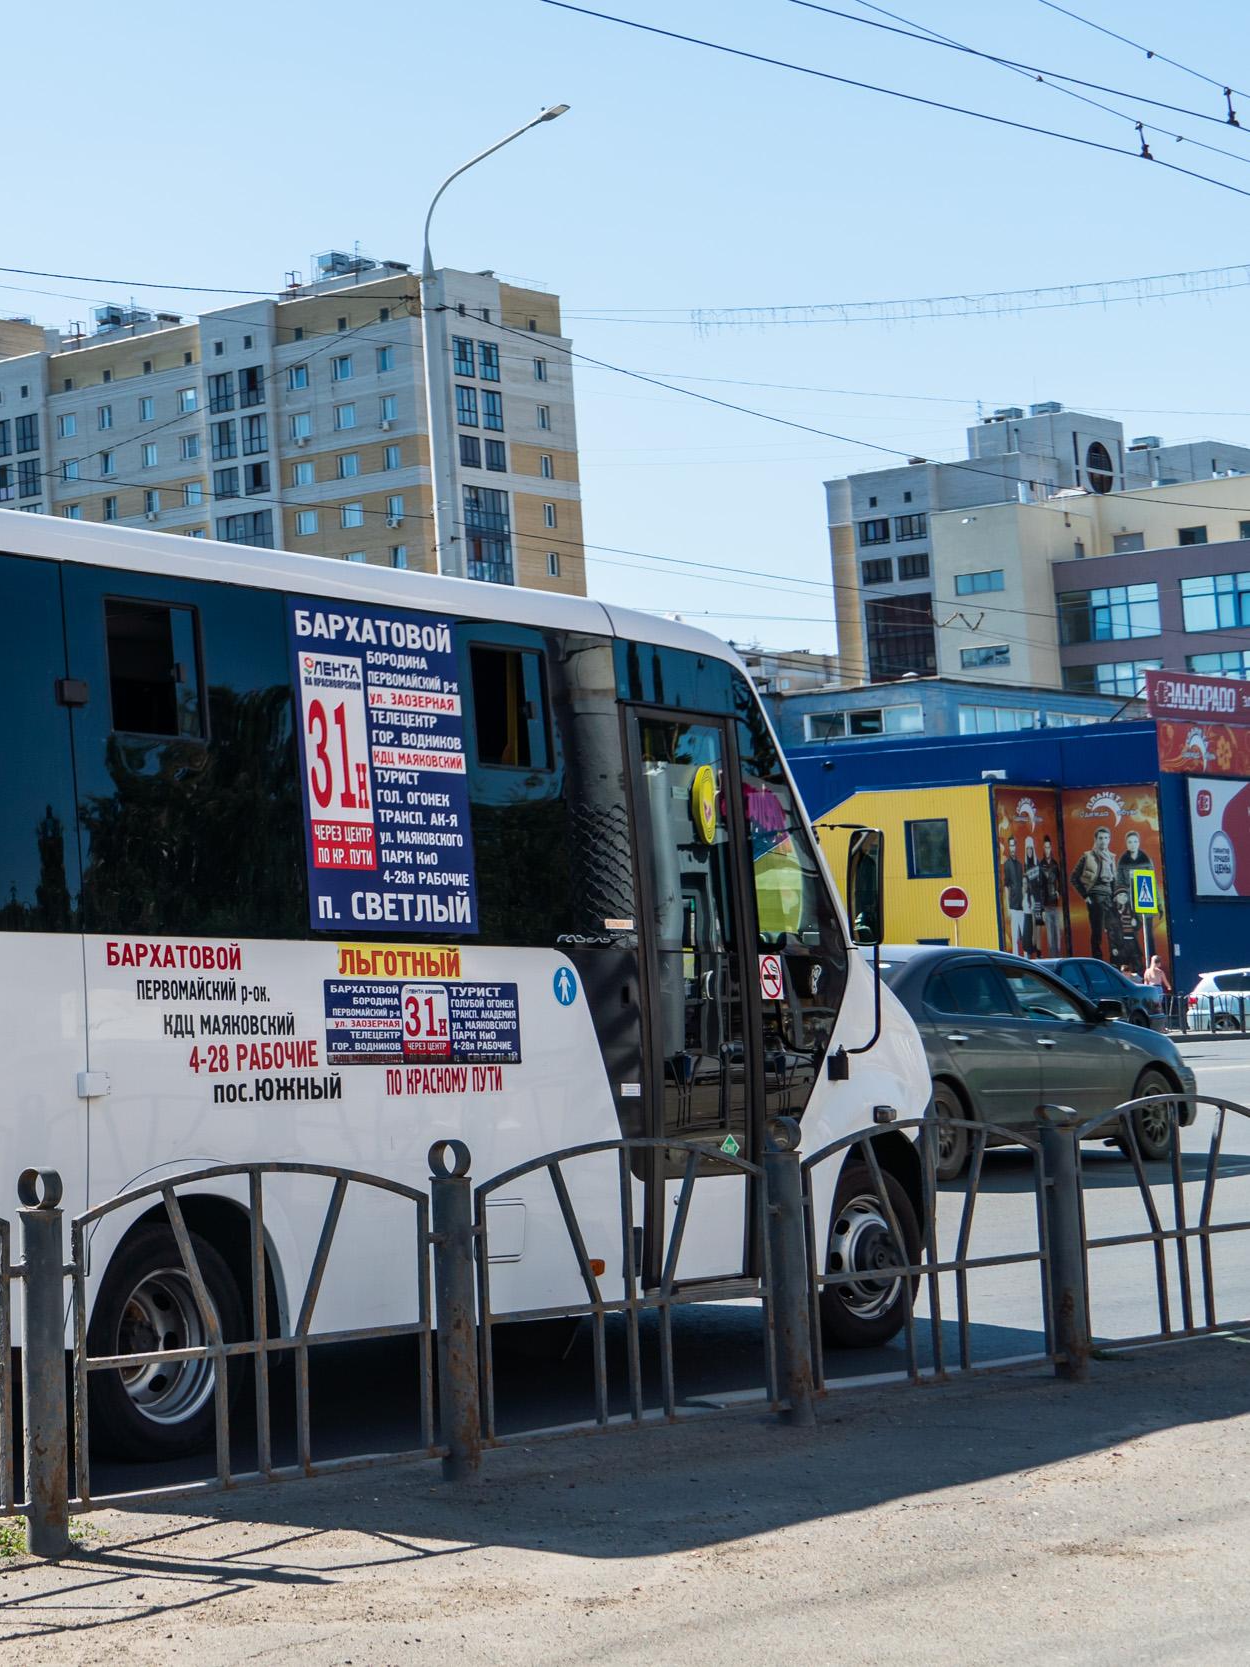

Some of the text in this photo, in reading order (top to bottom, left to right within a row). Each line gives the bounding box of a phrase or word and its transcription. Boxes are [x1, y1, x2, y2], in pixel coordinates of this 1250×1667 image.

[294, 608, 452, 654] БАРХАТОВОЙ
[313, 660, 361, 679] ЛЕНТА
[366, 650, 429, 671] БОРОДИНА
[367, 670, 442, 692] ПЕРВОМАЙСКИЙ
[370, 692, 455, 712] ул. ЗАОЗЕРНАЯ
[1166, 681, 1236, 713] ЭЛЬДОРАДО
[370, 710, 438, 729] ТЕЛЕЦЕНТР
[372, 729, 462, 751] ГОР. ВОДНИКОВ
[373, 750, 463, 770] КДЦ МАЯКОВСКИЙ
[375, 769, 420, 786] ТУРИСТ
[377, 789, 450, 807] ГОЛ. ОГОНЕК
[1086, 791, 1125, 810] ПЛАНЕТА
[378, 809, 458, 828] ТРАНСП. АК-Я
[314, 824, 372, 844] ЧЕРЕЗ ЦЕНТР
[379, 830, 463, 848] ул. МАЯКОВСКОГО
[317, 847, 373, 866] ПО КР. ПУТИ
[382, 849, 438, 865] ПАРК КиО
[383, 870, 470, 887] 4-28я РАБОЧИЕ
[317, 890, 472, 923] п. СВЕТЛЫЙ
[106, 942, 242, 971] БАРХАТОВОЙ
[338, 948, 461, 978] ЛЬГОТНЫЙ
[136, 976, 271, 1005] ПЕРВОМАЙСКИЙ р-ок.
[330, 984, 400, 995] БАРХАТОВОЙ
[449, 986, 502, 998] ТУРИСТ
[352, 996, 400, 1007] БОРОДИНА
[450, 998, 515, 1009] ГОЛУБОЙ ОГОНЕК
[332, 1007, 388, 1017] ПЕРВОМАЙСКИЙ
[451, 1009, 517, 1020] ТРАНСП. АКАДЕМИЯ
[163, 1011, 296, 1038] КДЦ МАЯКОВСКИЙ
[350, 1019, 401, 1028] ЗАОЗЕРНАЯ
[464, 1021, 517, 1031] МАЯКОВСКОГО
[349, 1030, 402, 1041] ТЕЛЕЦЕНТР
[452, 1031, 477, 1040] ПАРК
[332, 1041, 402, 1052] ГОР. ВОДНИКОВ
[407, 1041, 447, 1052] ЧЕРЕЗ ЦЕНТР
[452, 1041, 513, 1051] 4-28я РАБОЧИЕ
[189, 1040, 319, 1074] 4-28 РАБОЧИЕ
[386, 1065, 503, 1096] ПО КРАСНОМУ ПУТИ
